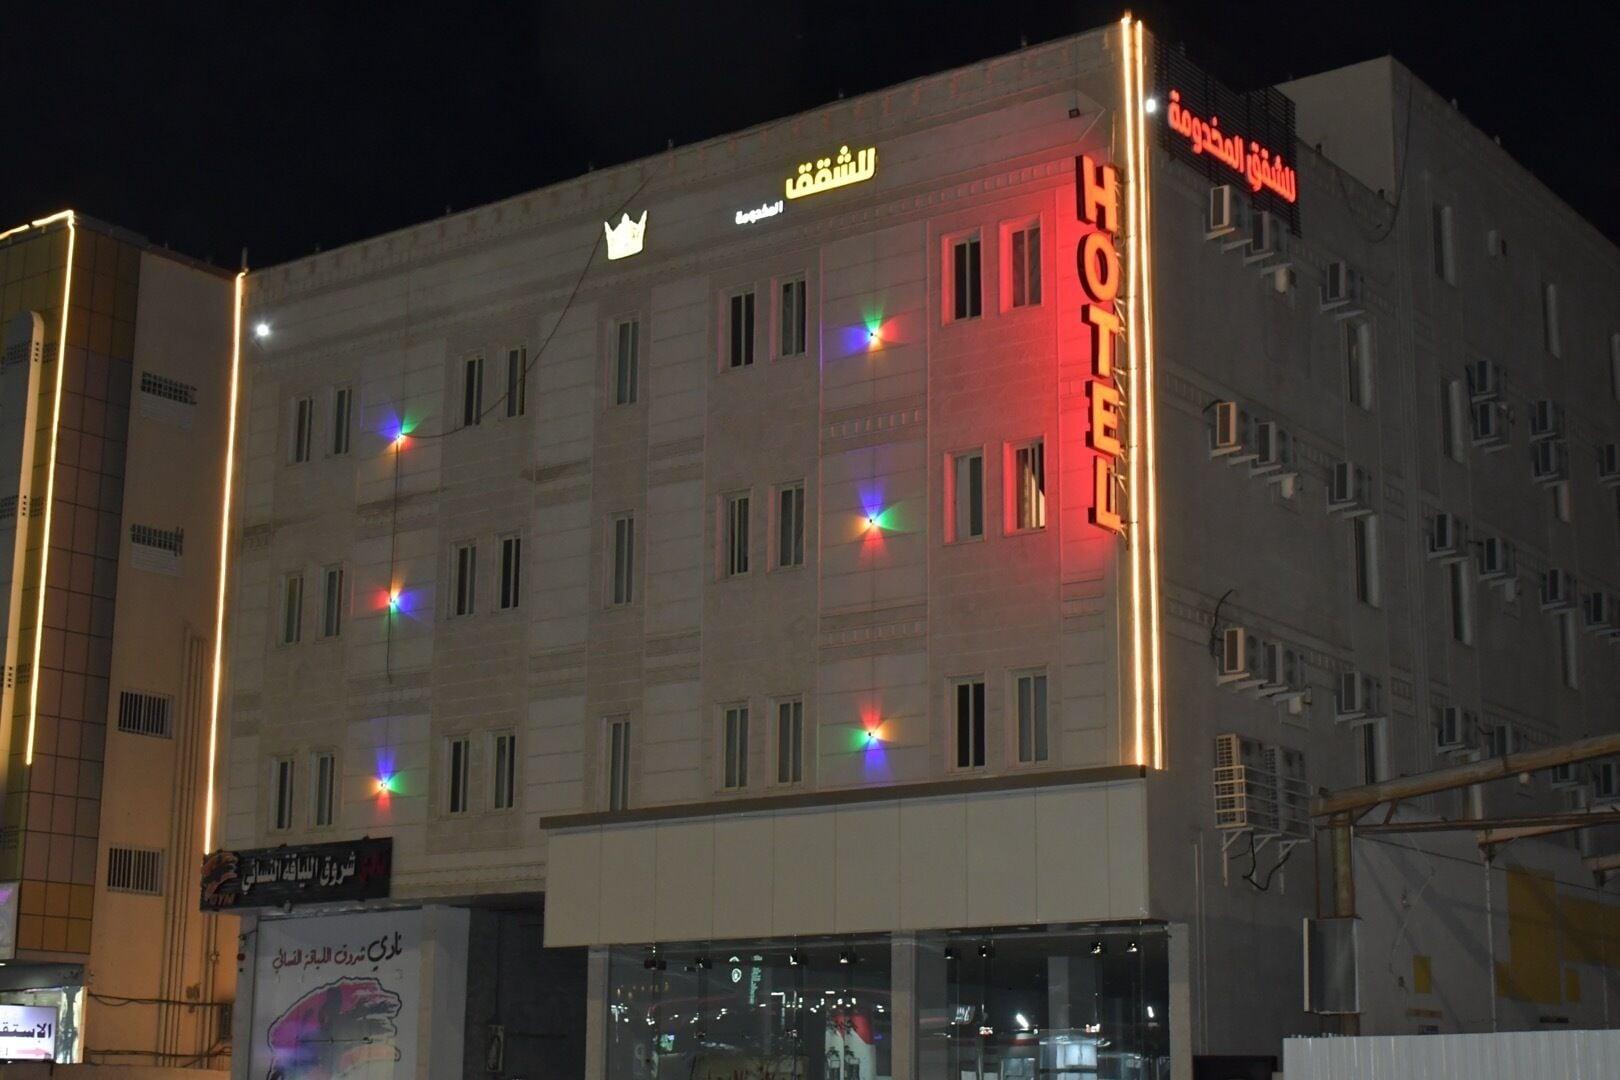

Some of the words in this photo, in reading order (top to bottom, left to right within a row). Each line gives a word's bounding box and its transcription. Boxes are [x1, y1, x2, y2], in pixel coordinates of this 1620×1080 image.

[1167, 90, 1245, 173] المخدومة
[785, 145, 876, 199] للشقق
[1246, 139, 1296, 203] للشقق
[1076, 154, 1121, 534] HOTEL
[241, 858, 282, 895] النسائي
[282, 853, 319, 888] اللياقة
[319, 850, 356, 886] شروق
[334, 944, 366, 966] شروق
[367, 931, 403, 972] نادي
